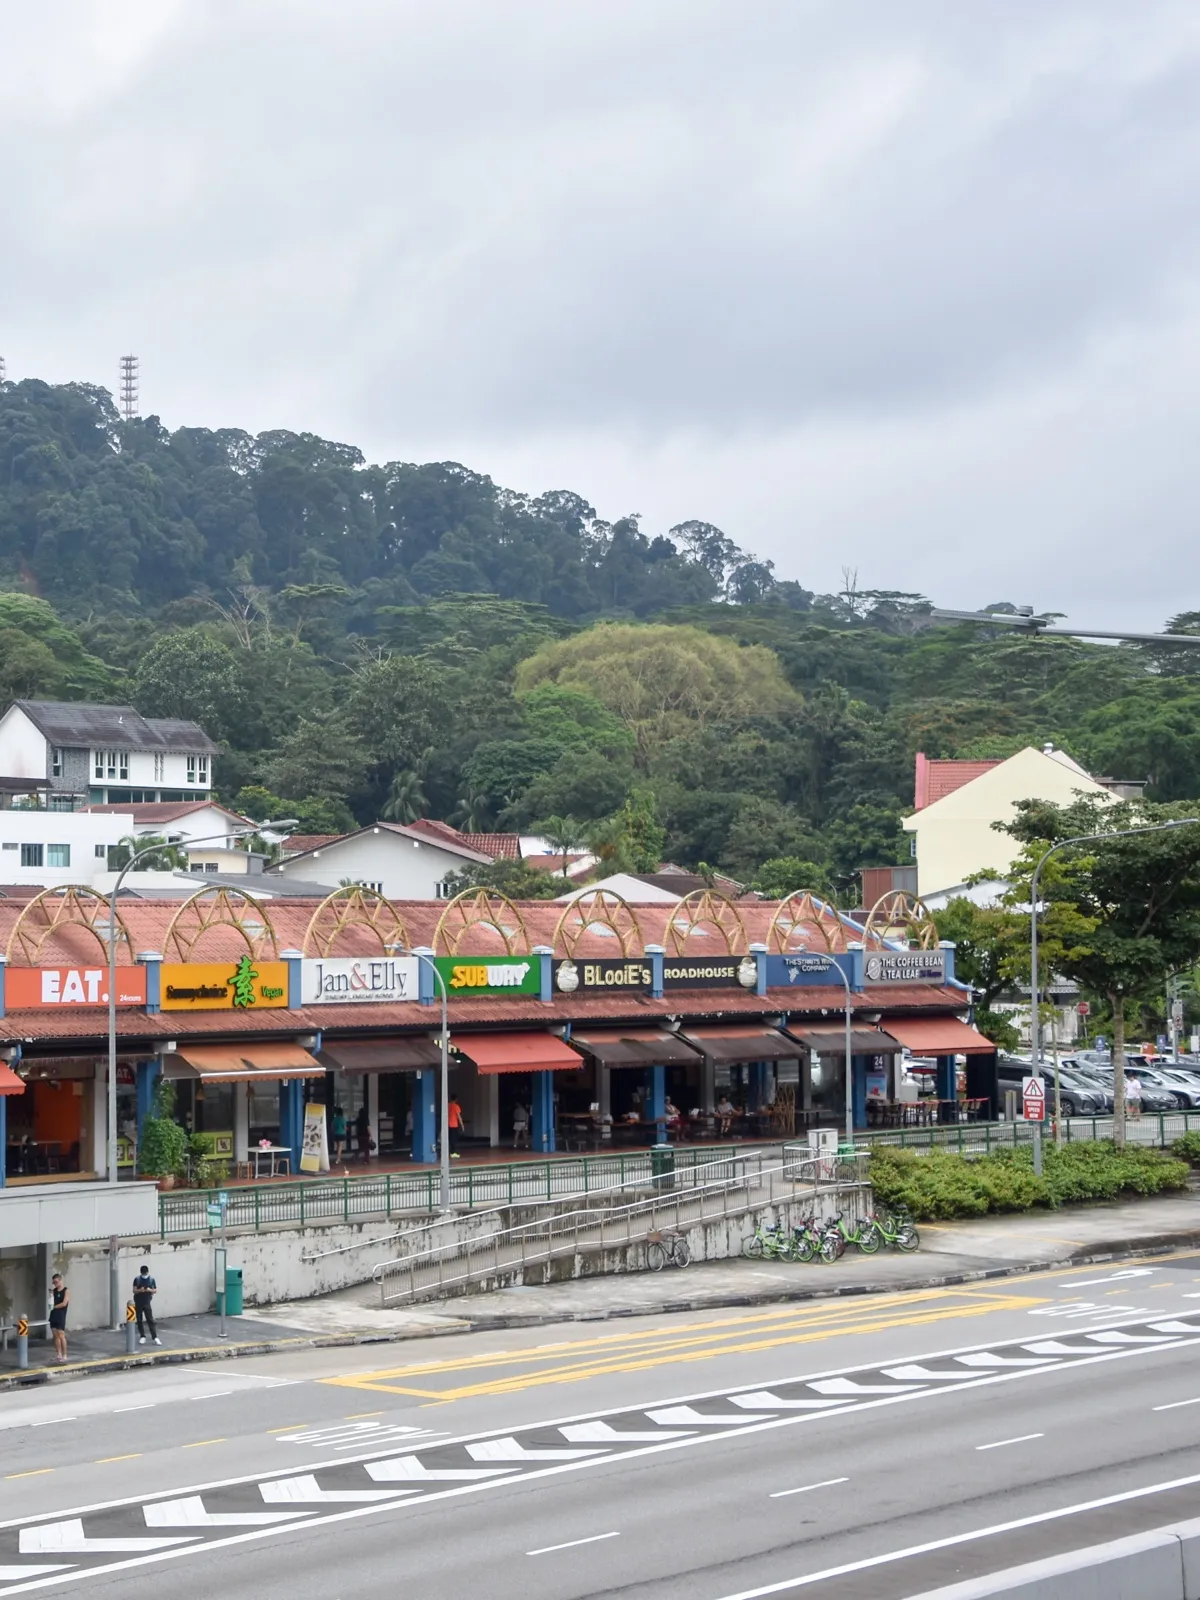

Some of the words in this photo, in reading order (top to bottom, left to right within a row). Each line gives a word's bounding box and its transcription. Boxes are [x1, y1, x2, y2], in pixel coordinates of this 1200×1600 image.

[801, 964, 830, 972] COMPANY
[881, 958, 895, 966] THE
[896, 957, 923, 967] COFFEE
[924, 956, 943, 966] BEAN
[449, 962, 531, 989] SUBWAY
[663, 966, 735, 979] ROADHOUSE
[887, 970, 900, 979] TEA
[901, 969, 919, 979] LEAF
[41, 970, 110, 1003] EAT.
[227, 954, 259, 1008] 素
[261, 986, 284, 1000] Vegan
[874, 1055, 884, 1066] 24
[275, 1421, 452, 1451] CITY
